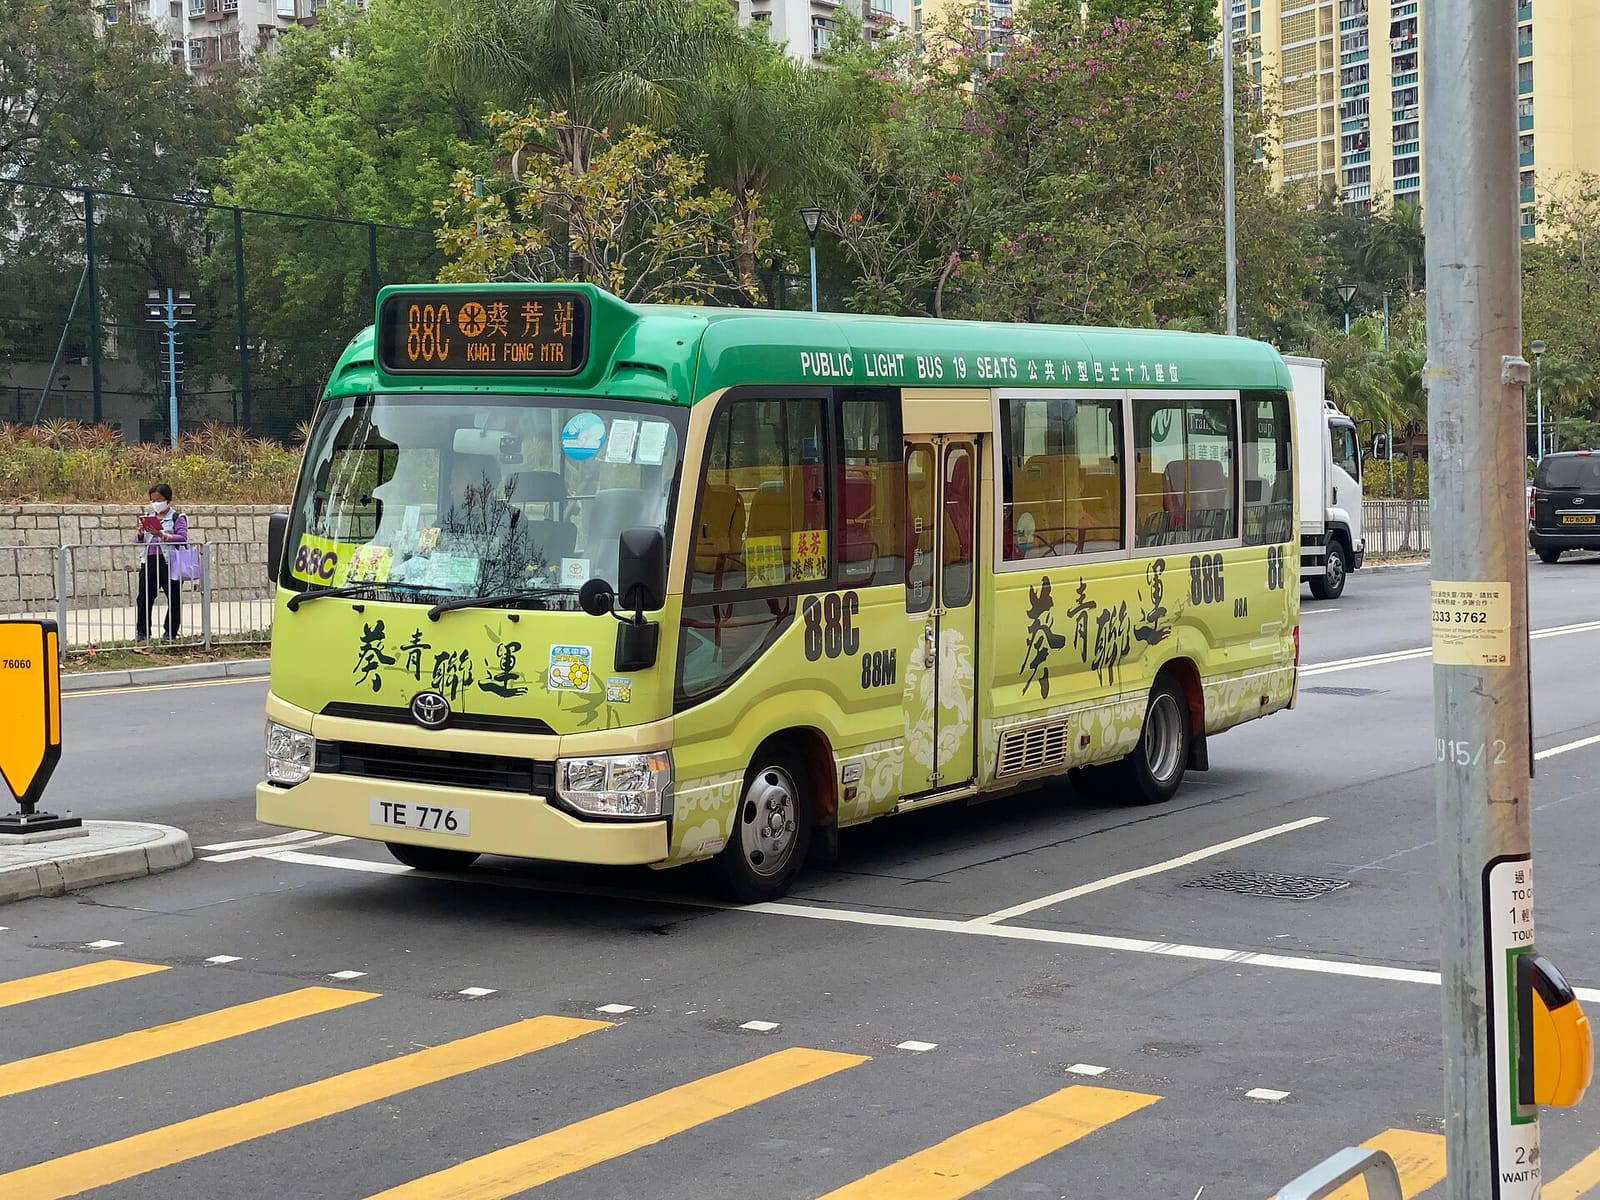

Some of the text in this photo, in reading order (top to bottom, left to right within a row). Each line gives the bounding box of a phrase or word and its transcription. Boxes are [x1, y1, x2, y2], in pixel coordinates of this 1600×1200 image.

[407, 304, 450, 361] 88C
[486, 301, 574, 337] 葵芳站
[467, 343, 564, 362] KWAI FONG MTR
[800, 352, 1017, 379] PUBLIC LIGHT BUS 19 SEATS
[1027, 359, 1179, 382] 公共小型巴士十九座位
[294, 545, 338, 579] 88C
[1190, 553, 1225, 606] 88G
[1234, 597, 1248, 618] 88A
[1454, 612, 1487, 624] 3762
[802, 590, 860, 662] 88C
[2, 659, 32, 669] 76060
[861, 649, 897, 689] 88M
[380, 802, 458, 831] TE 776
[1512, 889, 1526, 901] TO
[1502, 1171, 1529, 1183] WAIT
